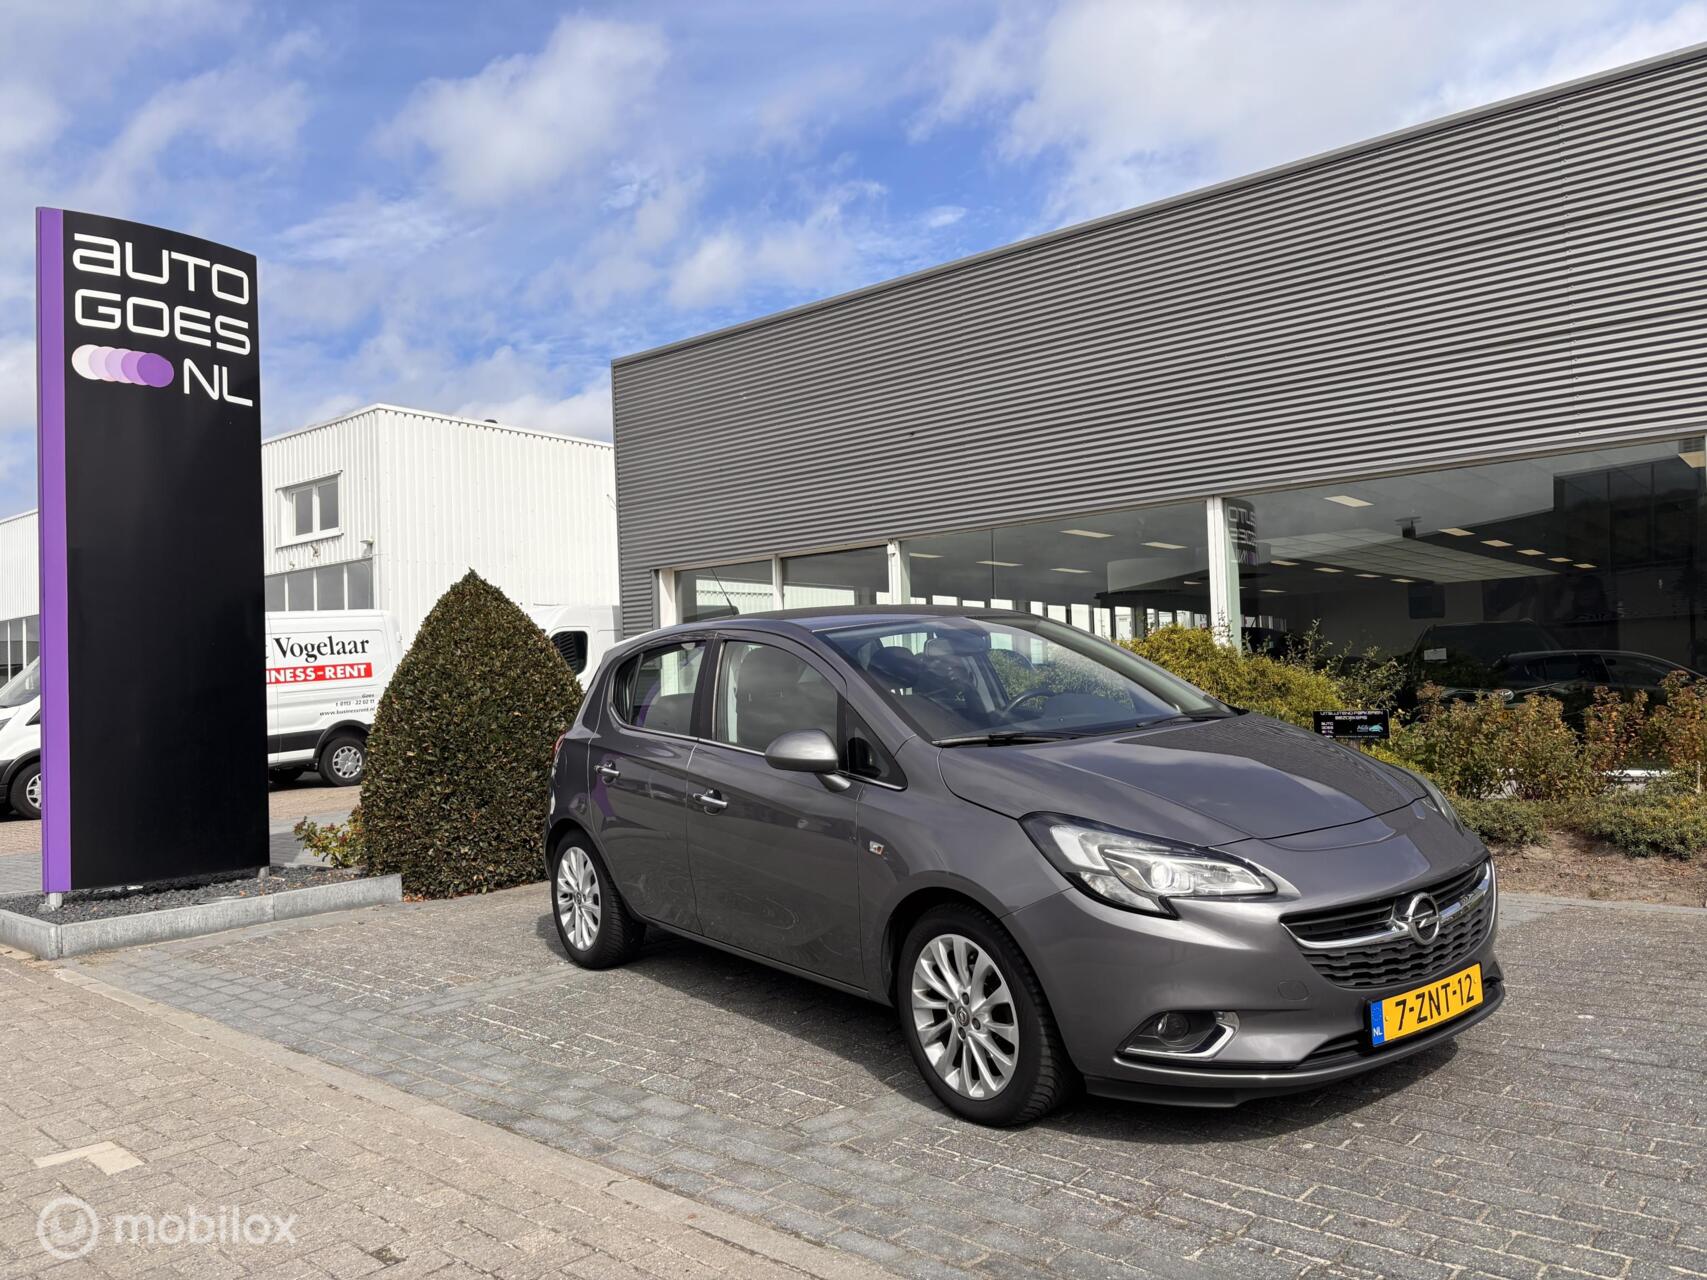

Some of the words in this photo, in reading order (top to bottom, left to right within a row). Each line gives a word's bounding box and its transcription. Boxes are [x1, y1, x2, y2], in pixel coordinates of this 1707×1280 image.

[74, 289, 251, 356] GOES
[183, 358, 253, 407] NL
[273, 635, 369, 663] Vogelaar
[1395, 973, 1475, 1031] 7-ZNT-12
[1372, 1026, 1383, 1037] NL
